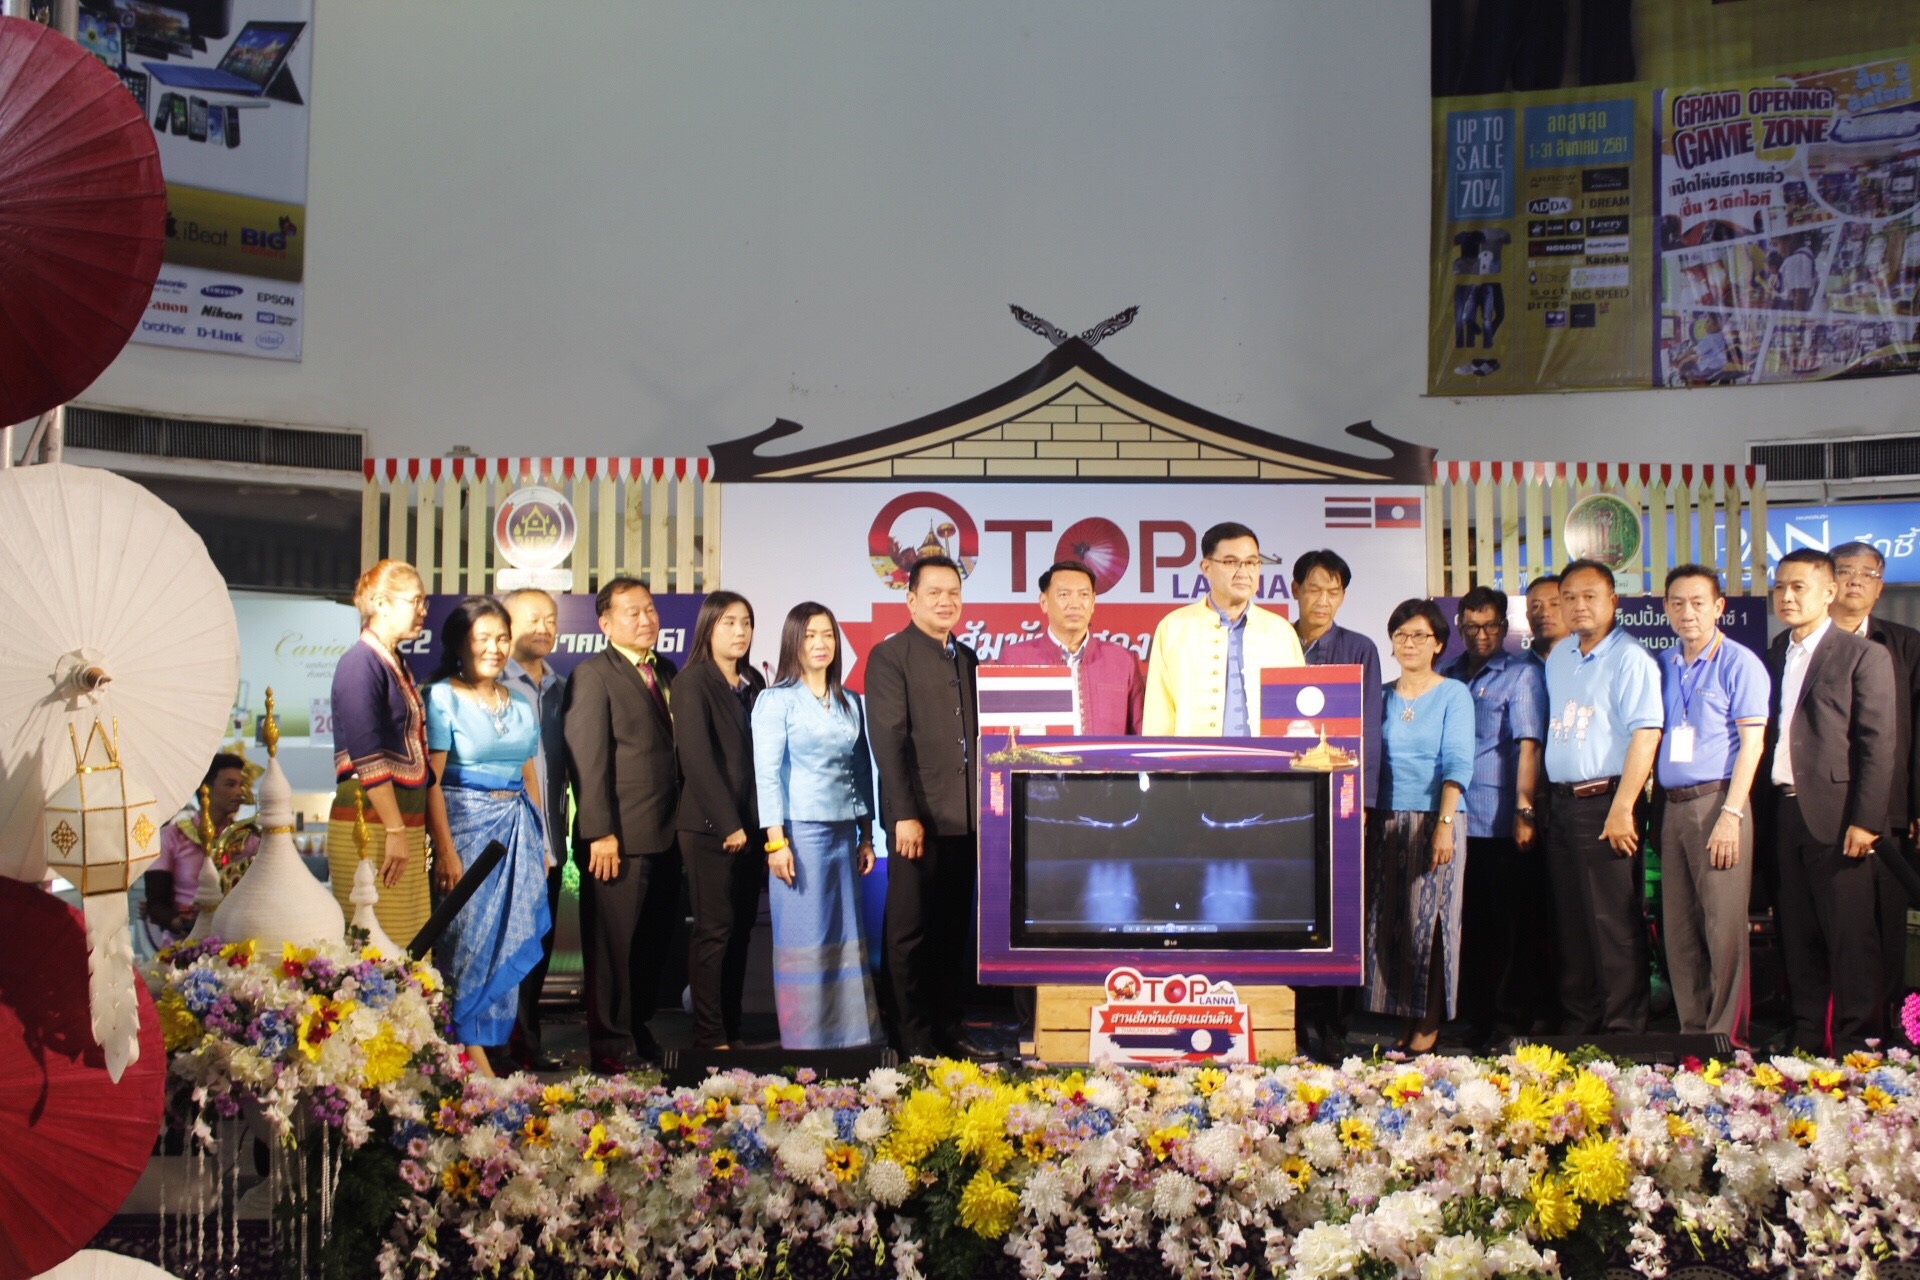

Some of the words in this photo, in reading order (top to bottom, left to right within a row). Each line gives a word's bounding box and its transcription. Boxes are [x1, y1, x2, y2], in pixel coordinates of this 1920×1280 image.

[1674, 91, 1742, 128] GRAND
[1748, 88, 1834, 114] OPENING
[1457, 118, 1477, 144] UP
[1483, 116, 1503, 142] TO
[1674, 120, 1755, 170] GAME
[1761, 115, 1830, 150] ZONE
[1456, 144, 1504, 171] SALE
[1460, 178, 1499, 209] 70%
[1530, 199, 1568, 213] ADDA
[183, 221, 229, 246] iBeat
[240, 227, 287, 250] BIG
[257, 292, 295, 307] EPSON
[201, 304, 243, 321] Nikon
[142, 320, 186, 335] brother
[197, 327, 244, 343] D-Link
[1199, 996, 1236, 1005] LANNA
